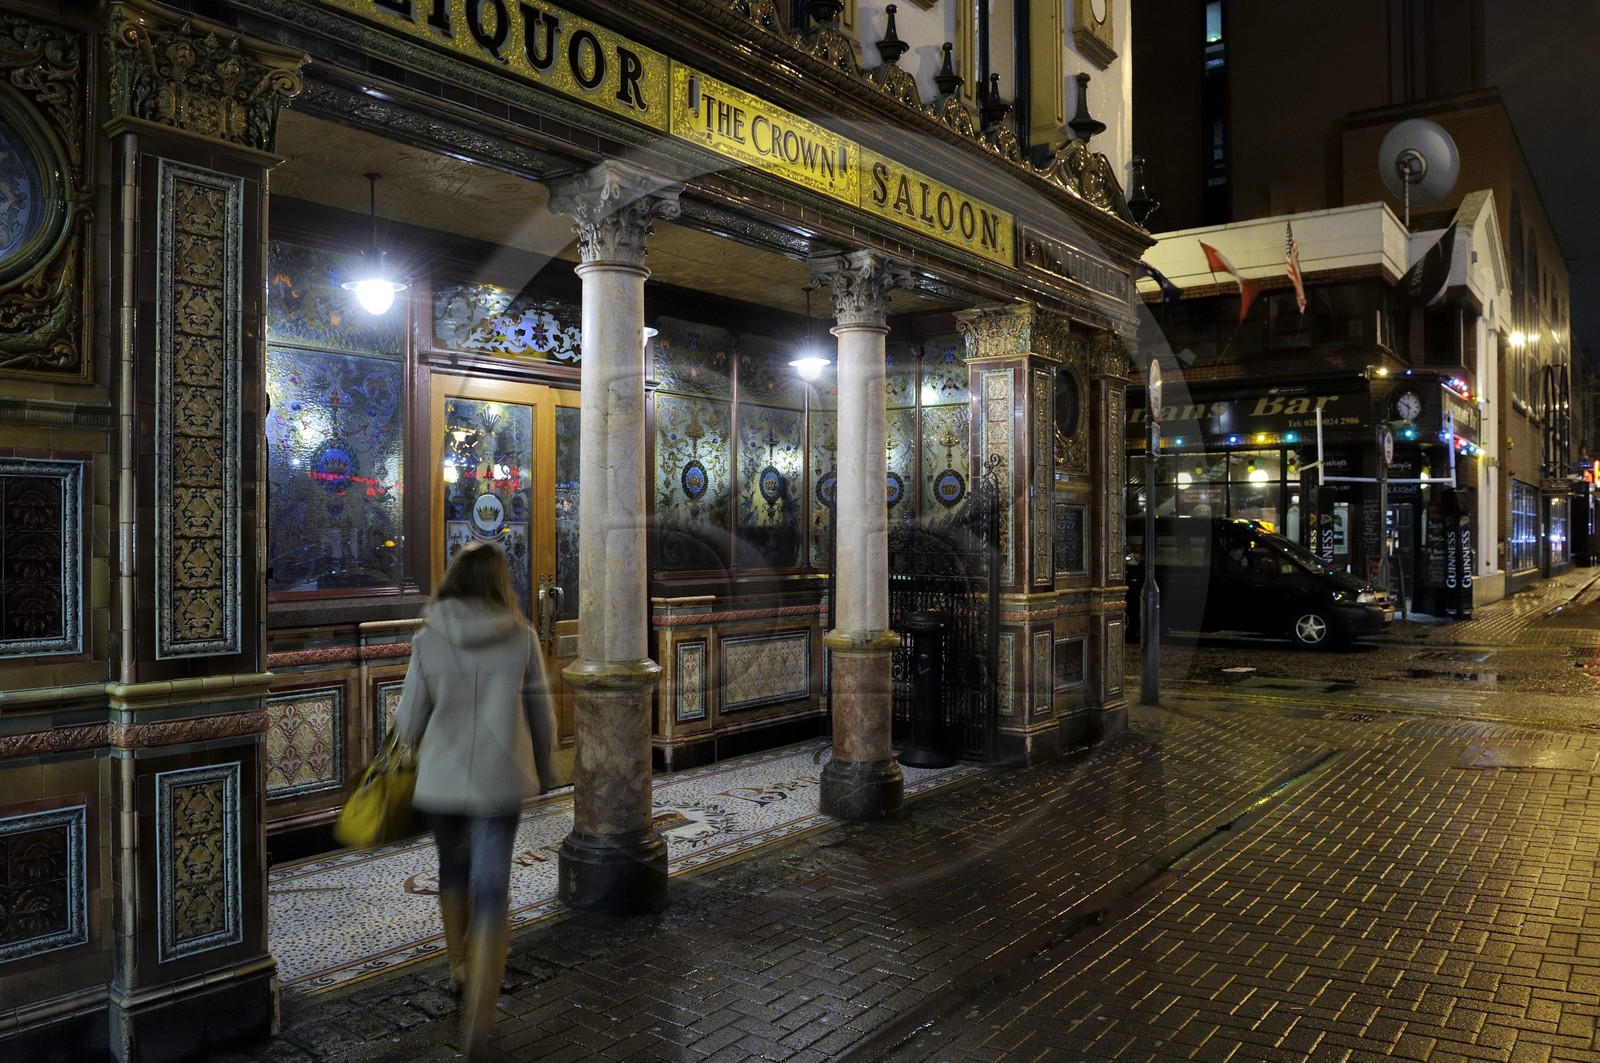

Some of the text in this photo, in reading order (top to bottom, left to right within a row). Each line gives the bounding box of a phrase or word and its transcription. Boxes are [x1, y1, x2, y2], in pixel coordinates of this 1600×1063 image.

[701, 93, 836, 181] THE CROWN
[1248, 395, 1339, 417] Bar
[1321, 417, 1339, 426] 024
[1340, 416, 1360, 425] 2986
[1446, 530, 1458, 588] GUINNESS
[1461, 530, 1473, 588] GUINNESS
